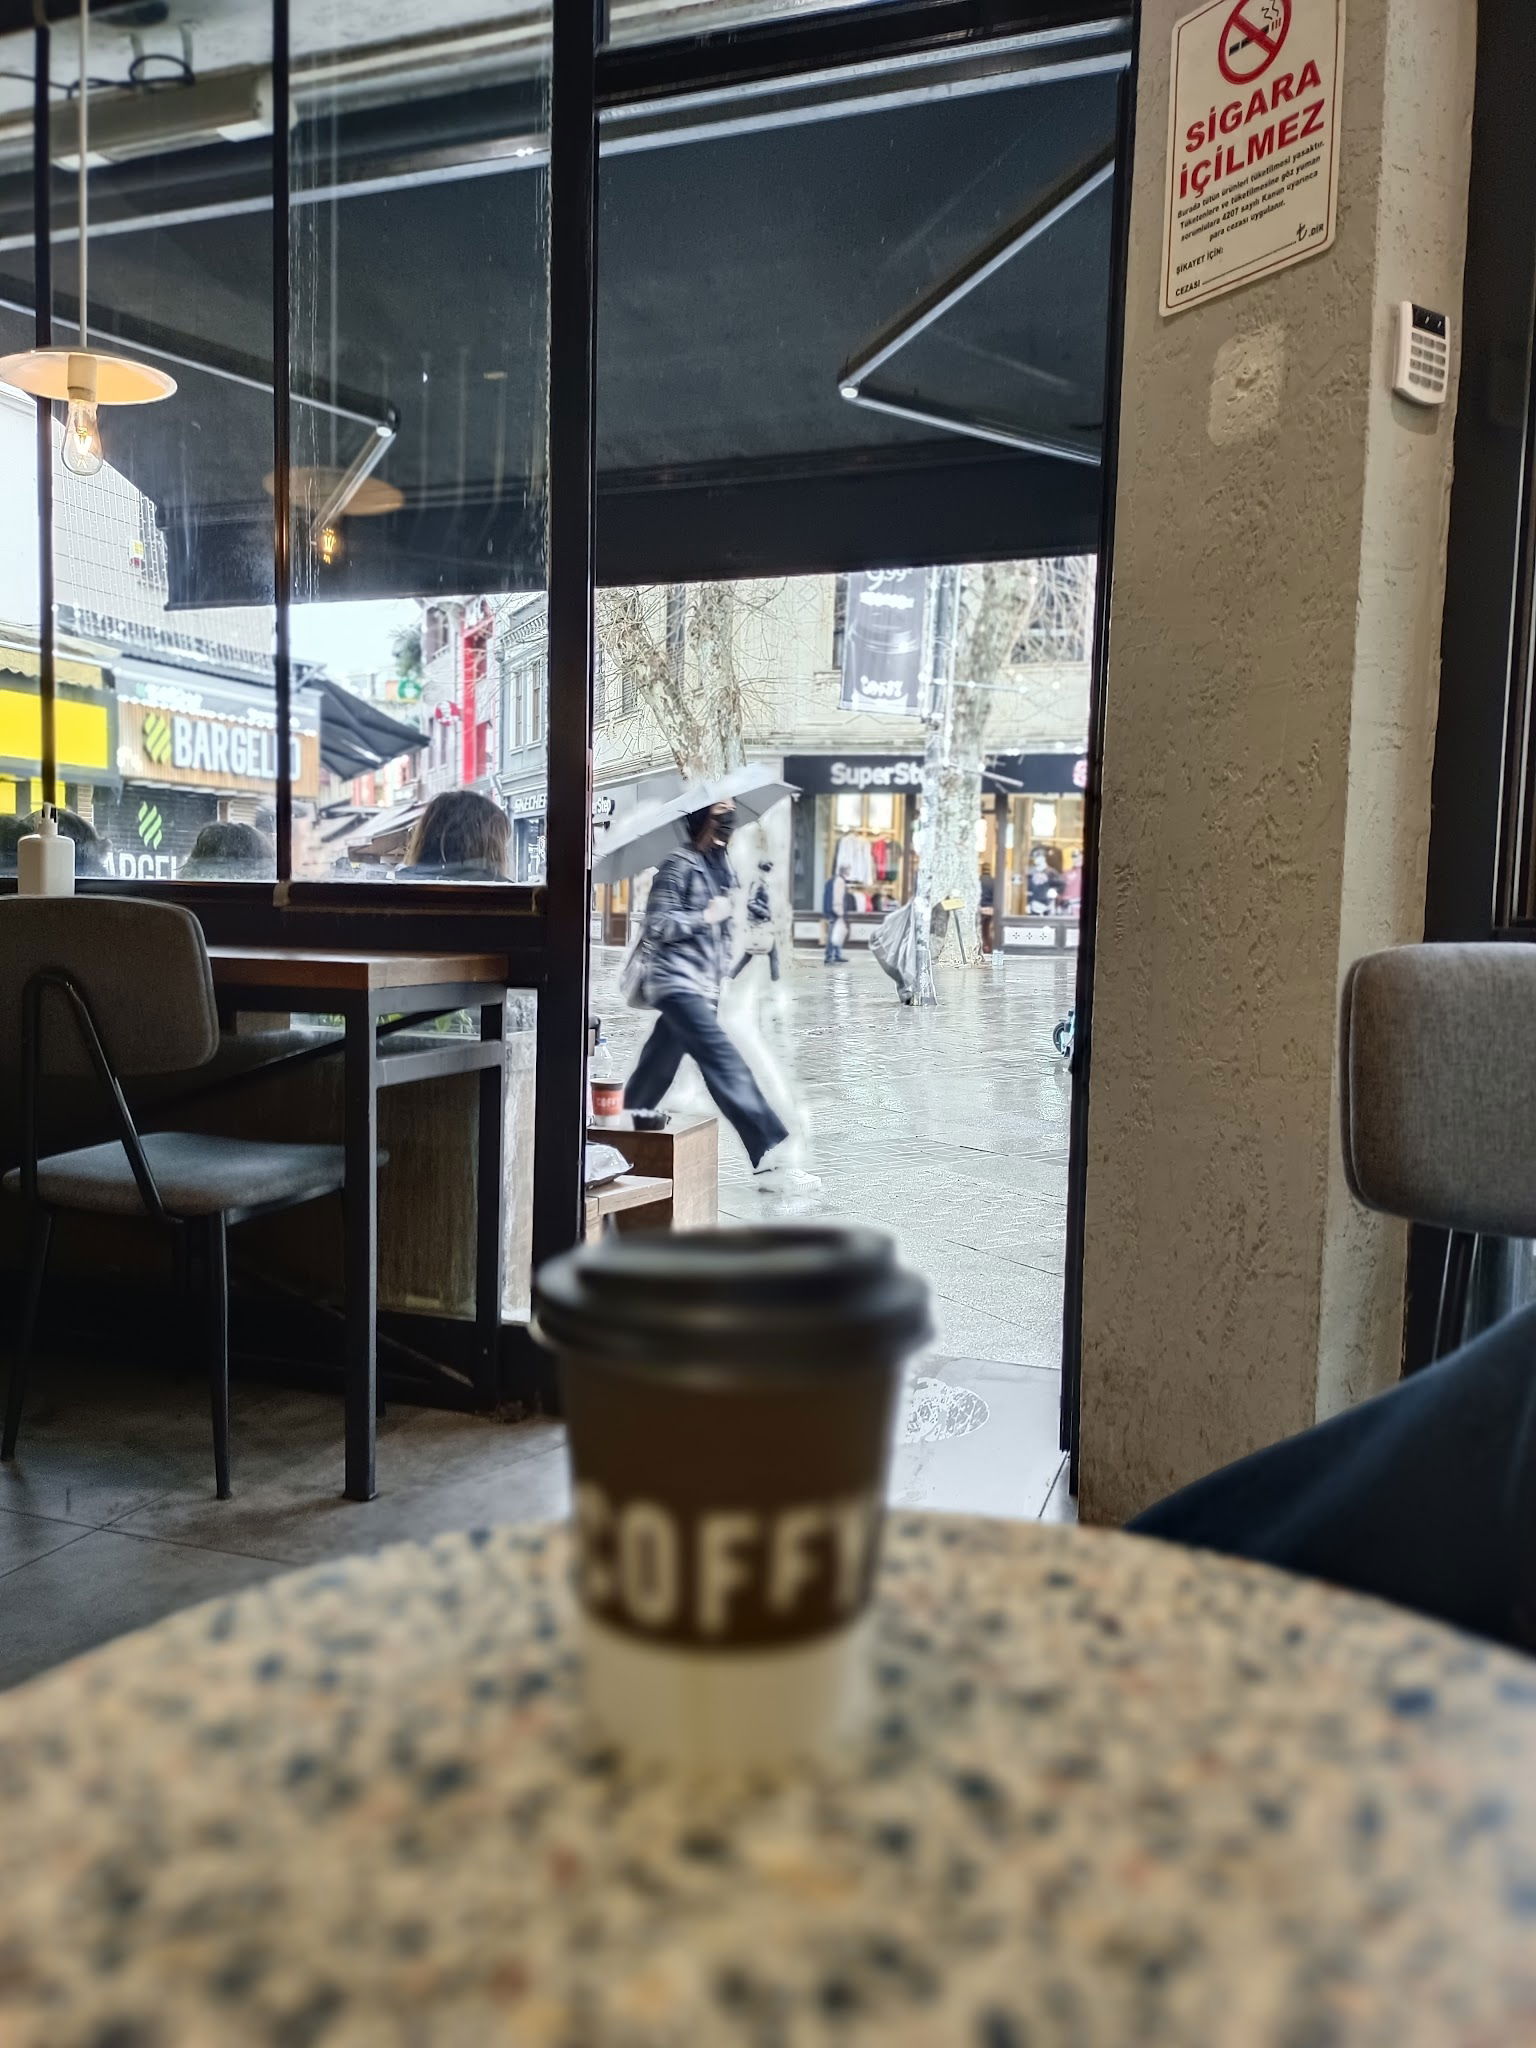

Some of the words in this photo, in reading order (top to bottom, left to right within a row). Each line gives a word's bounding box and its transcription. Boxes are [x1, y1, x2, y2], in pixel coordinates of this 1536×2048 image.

[1185, 59, 1322, 153] SİGARA
[1179, 98, 1325, 199] İÇİLMEZ
[1221, 201, 1229, 209] ve
[1295, 155, 1321, 175] yuman
[1222, 206, 1239, 221] 4207
[1261, 187, 1285, 203] Kanun
[1177, 202, 1201, 219] Burada
[1208, 228, 1225, 243] para
